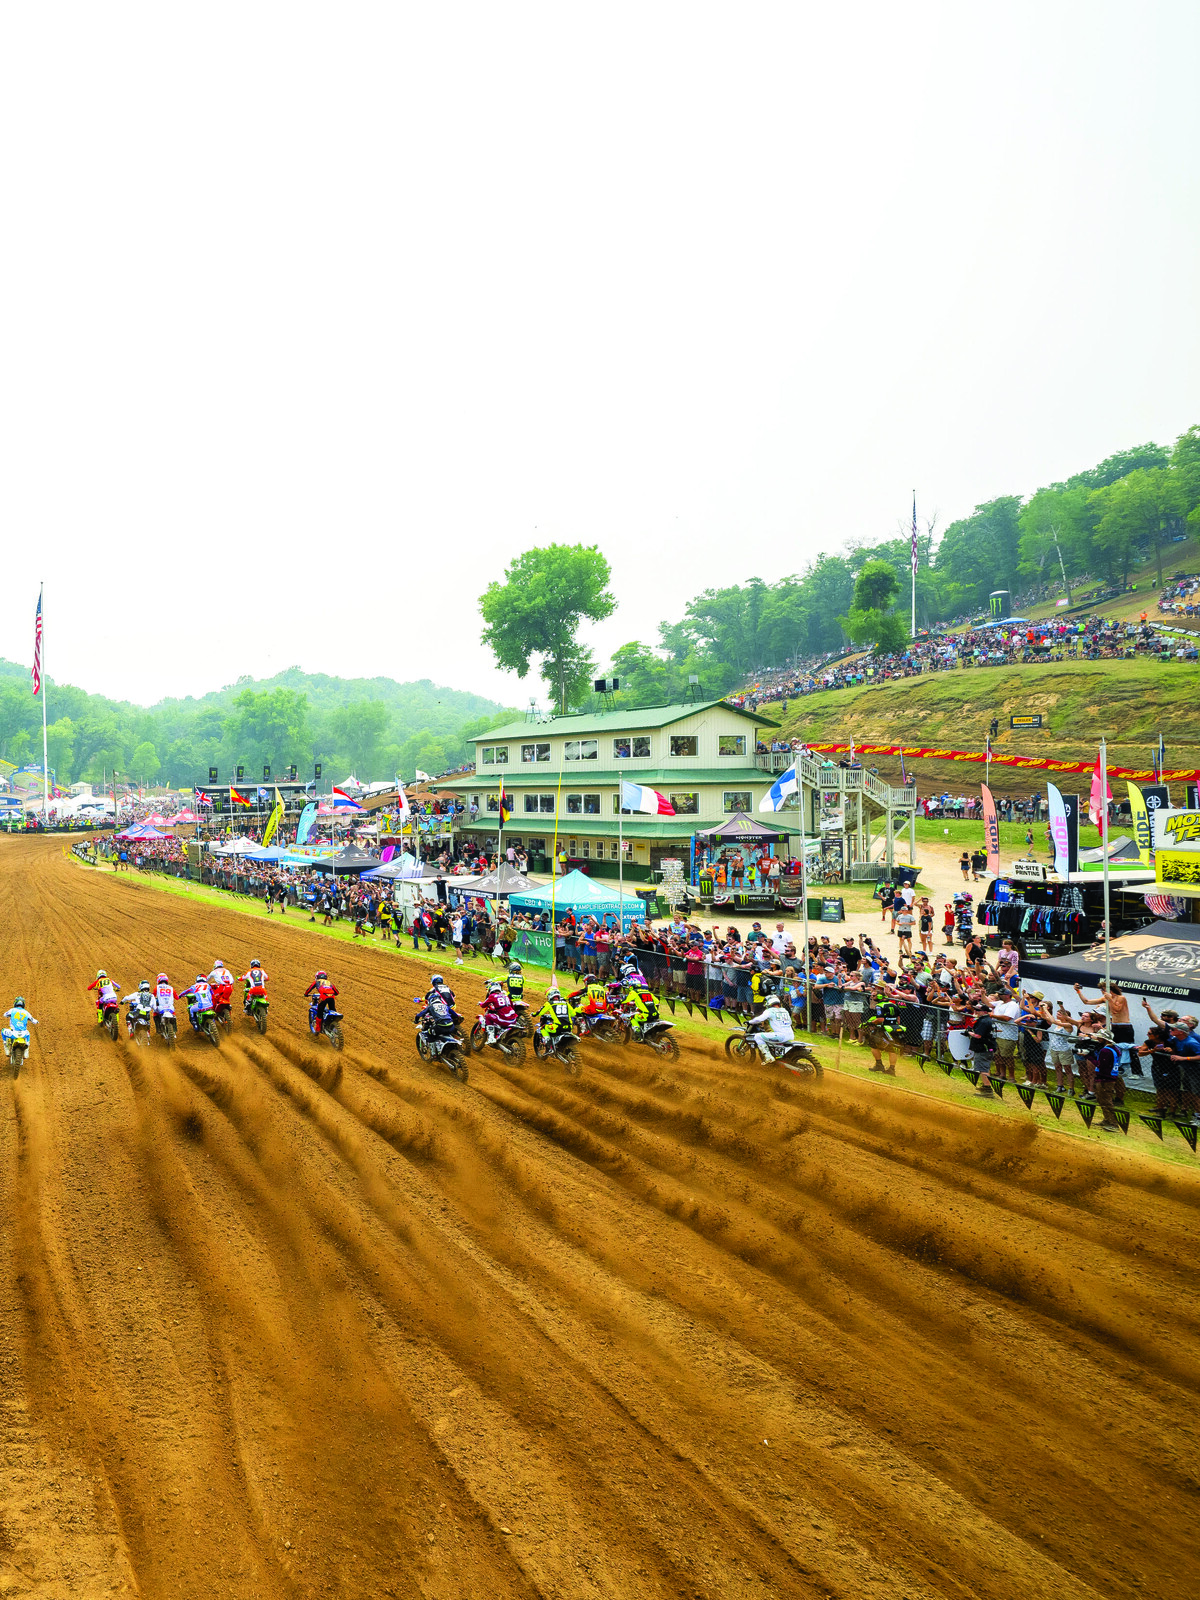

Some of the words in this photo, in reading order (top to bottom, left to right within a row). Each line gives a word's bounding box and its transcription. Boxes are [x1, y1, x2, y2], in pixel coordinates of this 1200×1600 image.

[534, 936, 552, 947] THC
[160, 988, 172, 996] 69
[1099, 978, 1190, 996] WW.MCGINLEYCLINIC.COM
[556, 1004, 568, 1014] 66
[14, 1012, 26, 1021] 47
